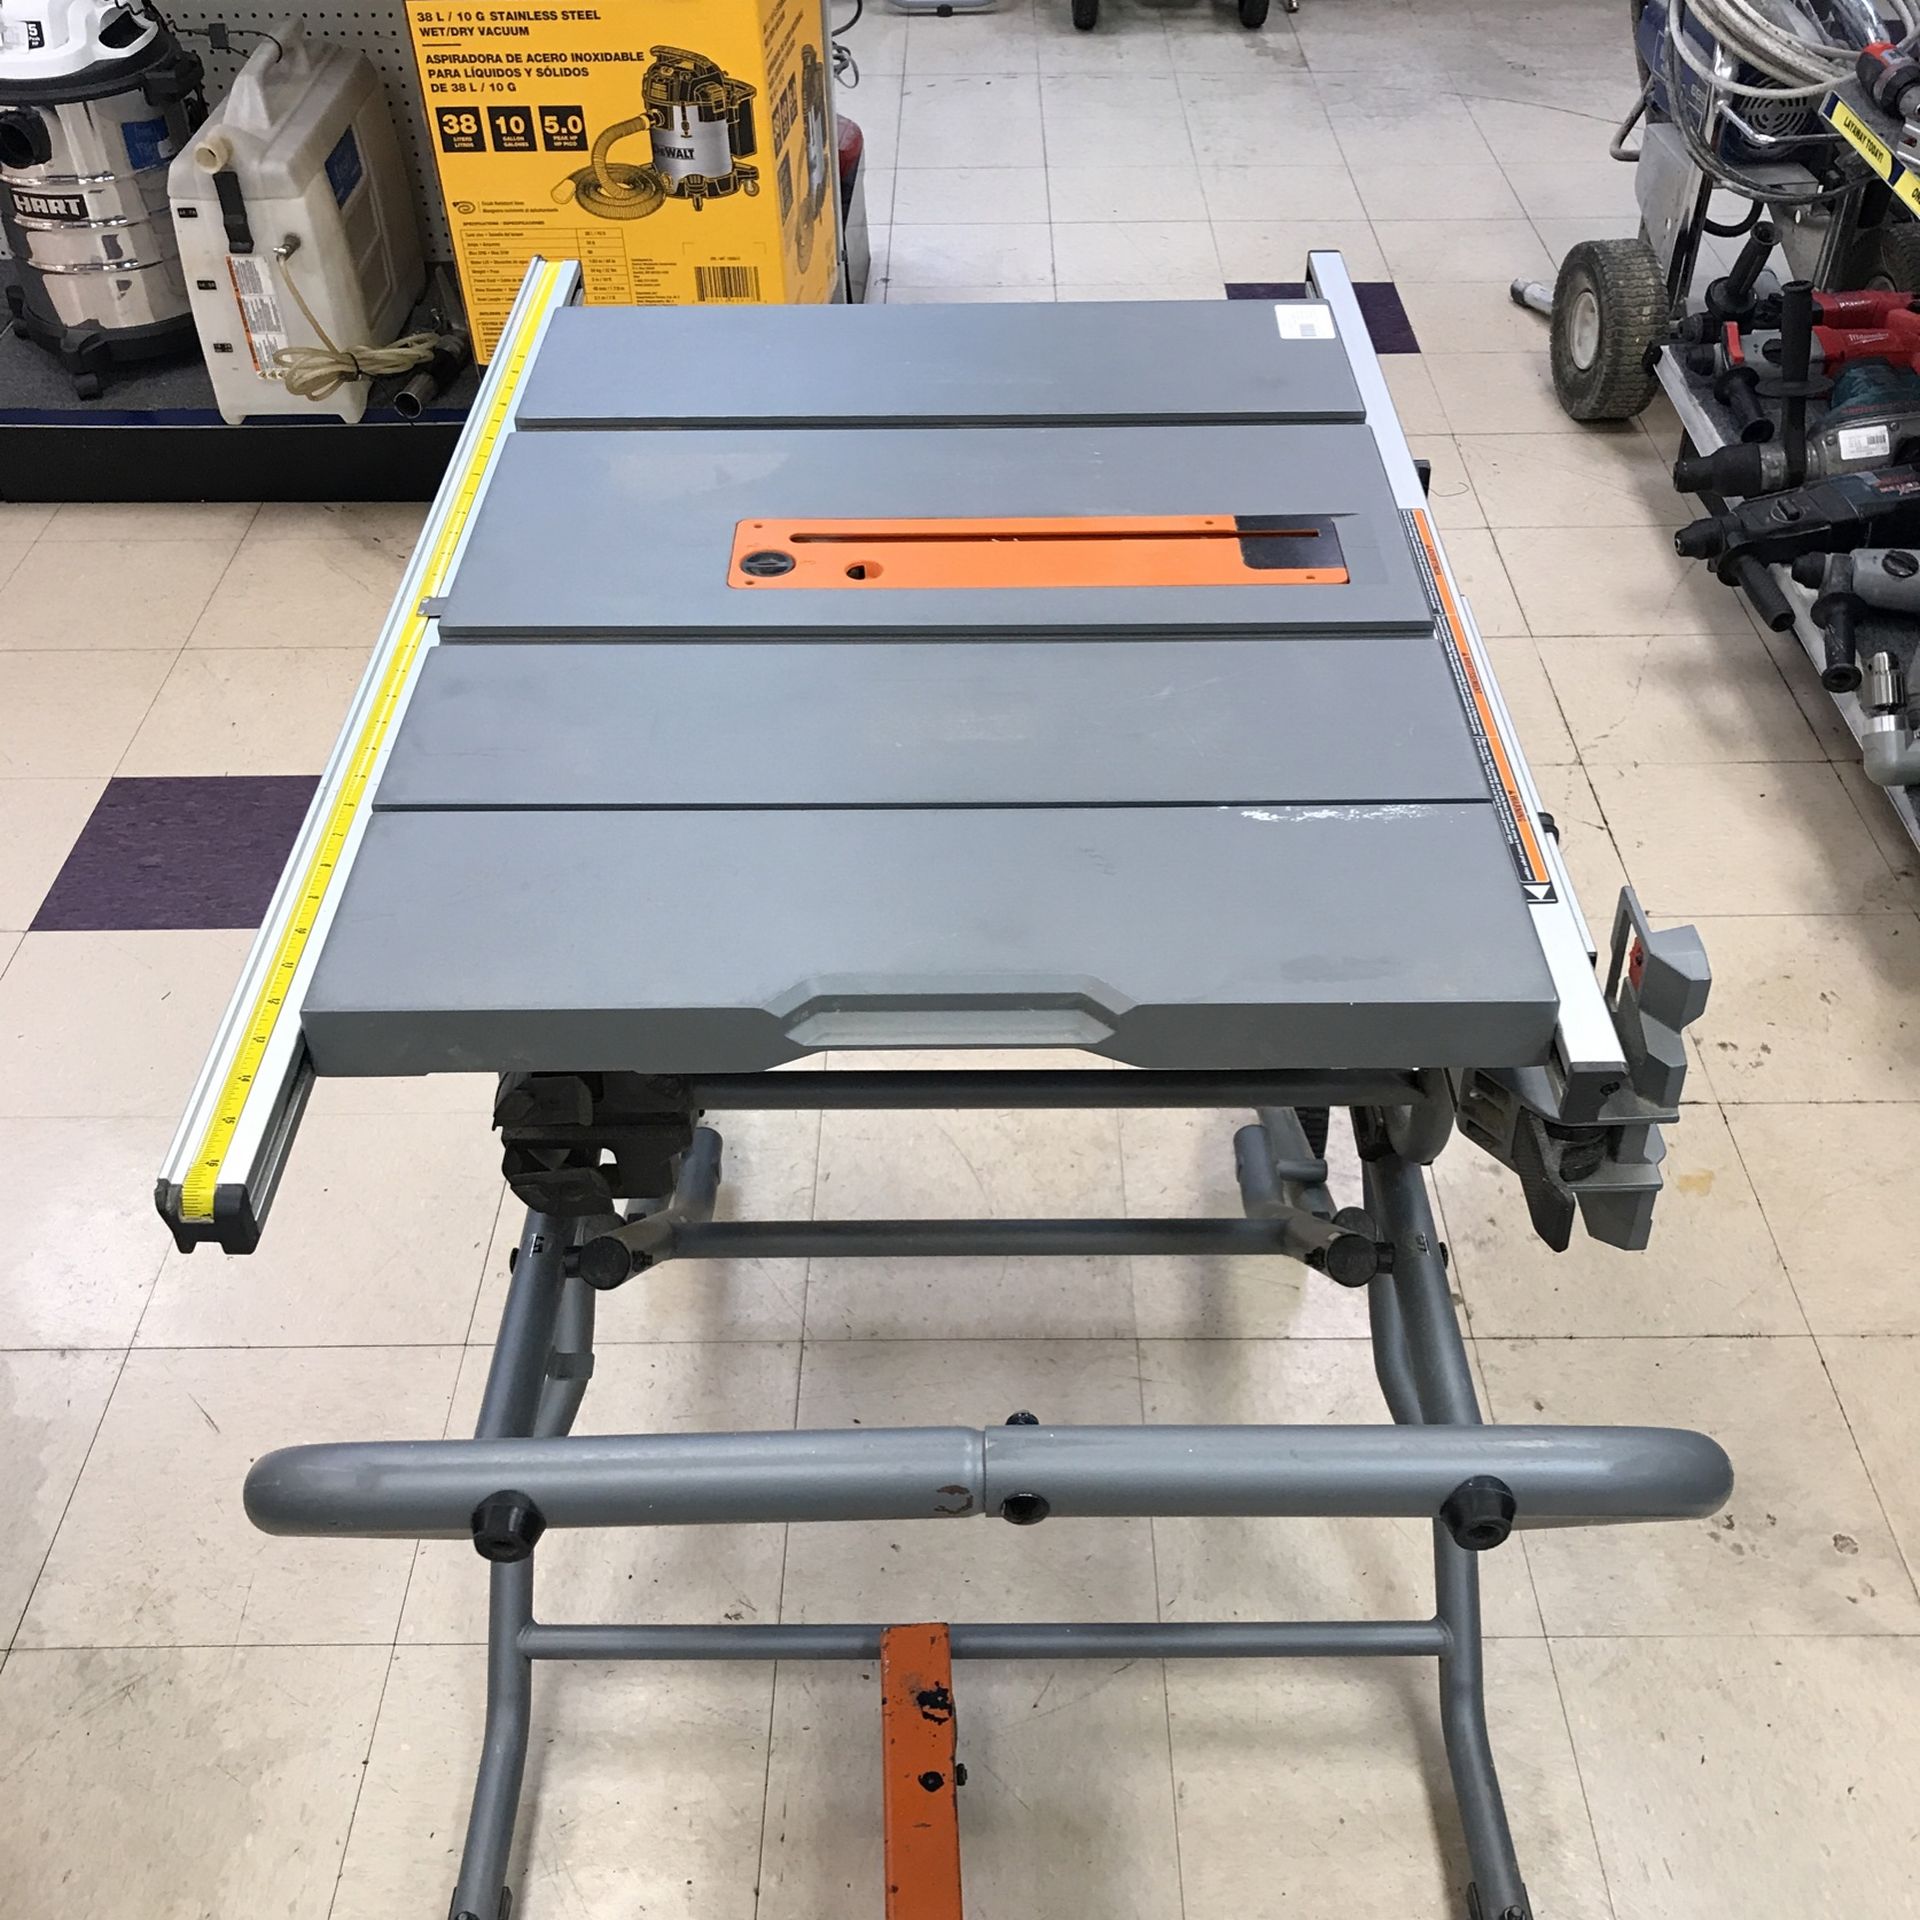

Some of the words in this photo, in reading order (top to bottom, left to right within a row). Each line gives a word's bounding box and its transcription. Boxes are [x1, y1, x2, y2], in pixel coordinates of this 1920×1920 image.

[417, 12, 433, 22] 38
[436, 12, 444, 22] L
[458, 12, 472, 22] 10
[476, 12, 485, 22] G
[490, 11, 558, 21] STAINLESS
[561, 10, 601, 20] STEEL
[420, 27, 474, 37] WET/DRY
[478, 26, 530, 36] VACUUM
[426, 53, 502, 64] ASPIRADORA
[507, 53, 523, 63] DE
[526, 52, 568, 63] ACERO
[572, 52, 644, 62] INOXIDABLE
[428, 68, 461, 78] PARA
[465, 66, 522, 78] LÍQUIDOS
[525, 68, 532, 77] Y
[536, 65, 590, 78] SÓLIDOS
[431, 83, 448, 93] DE
[451, 83, 466, 92] 38
[470, 83, 477, 92] L
[489, 82, 504, 92] 10
[508, 82, 516, 92] G
[442, 114, 478, 135] 38
[496, 116, 525, 134] 10
[544, 116, 582, 134] 5.0
[1843, 116, 1867, 145] LAYAWAY
[13, 194, 80, 216] HART
